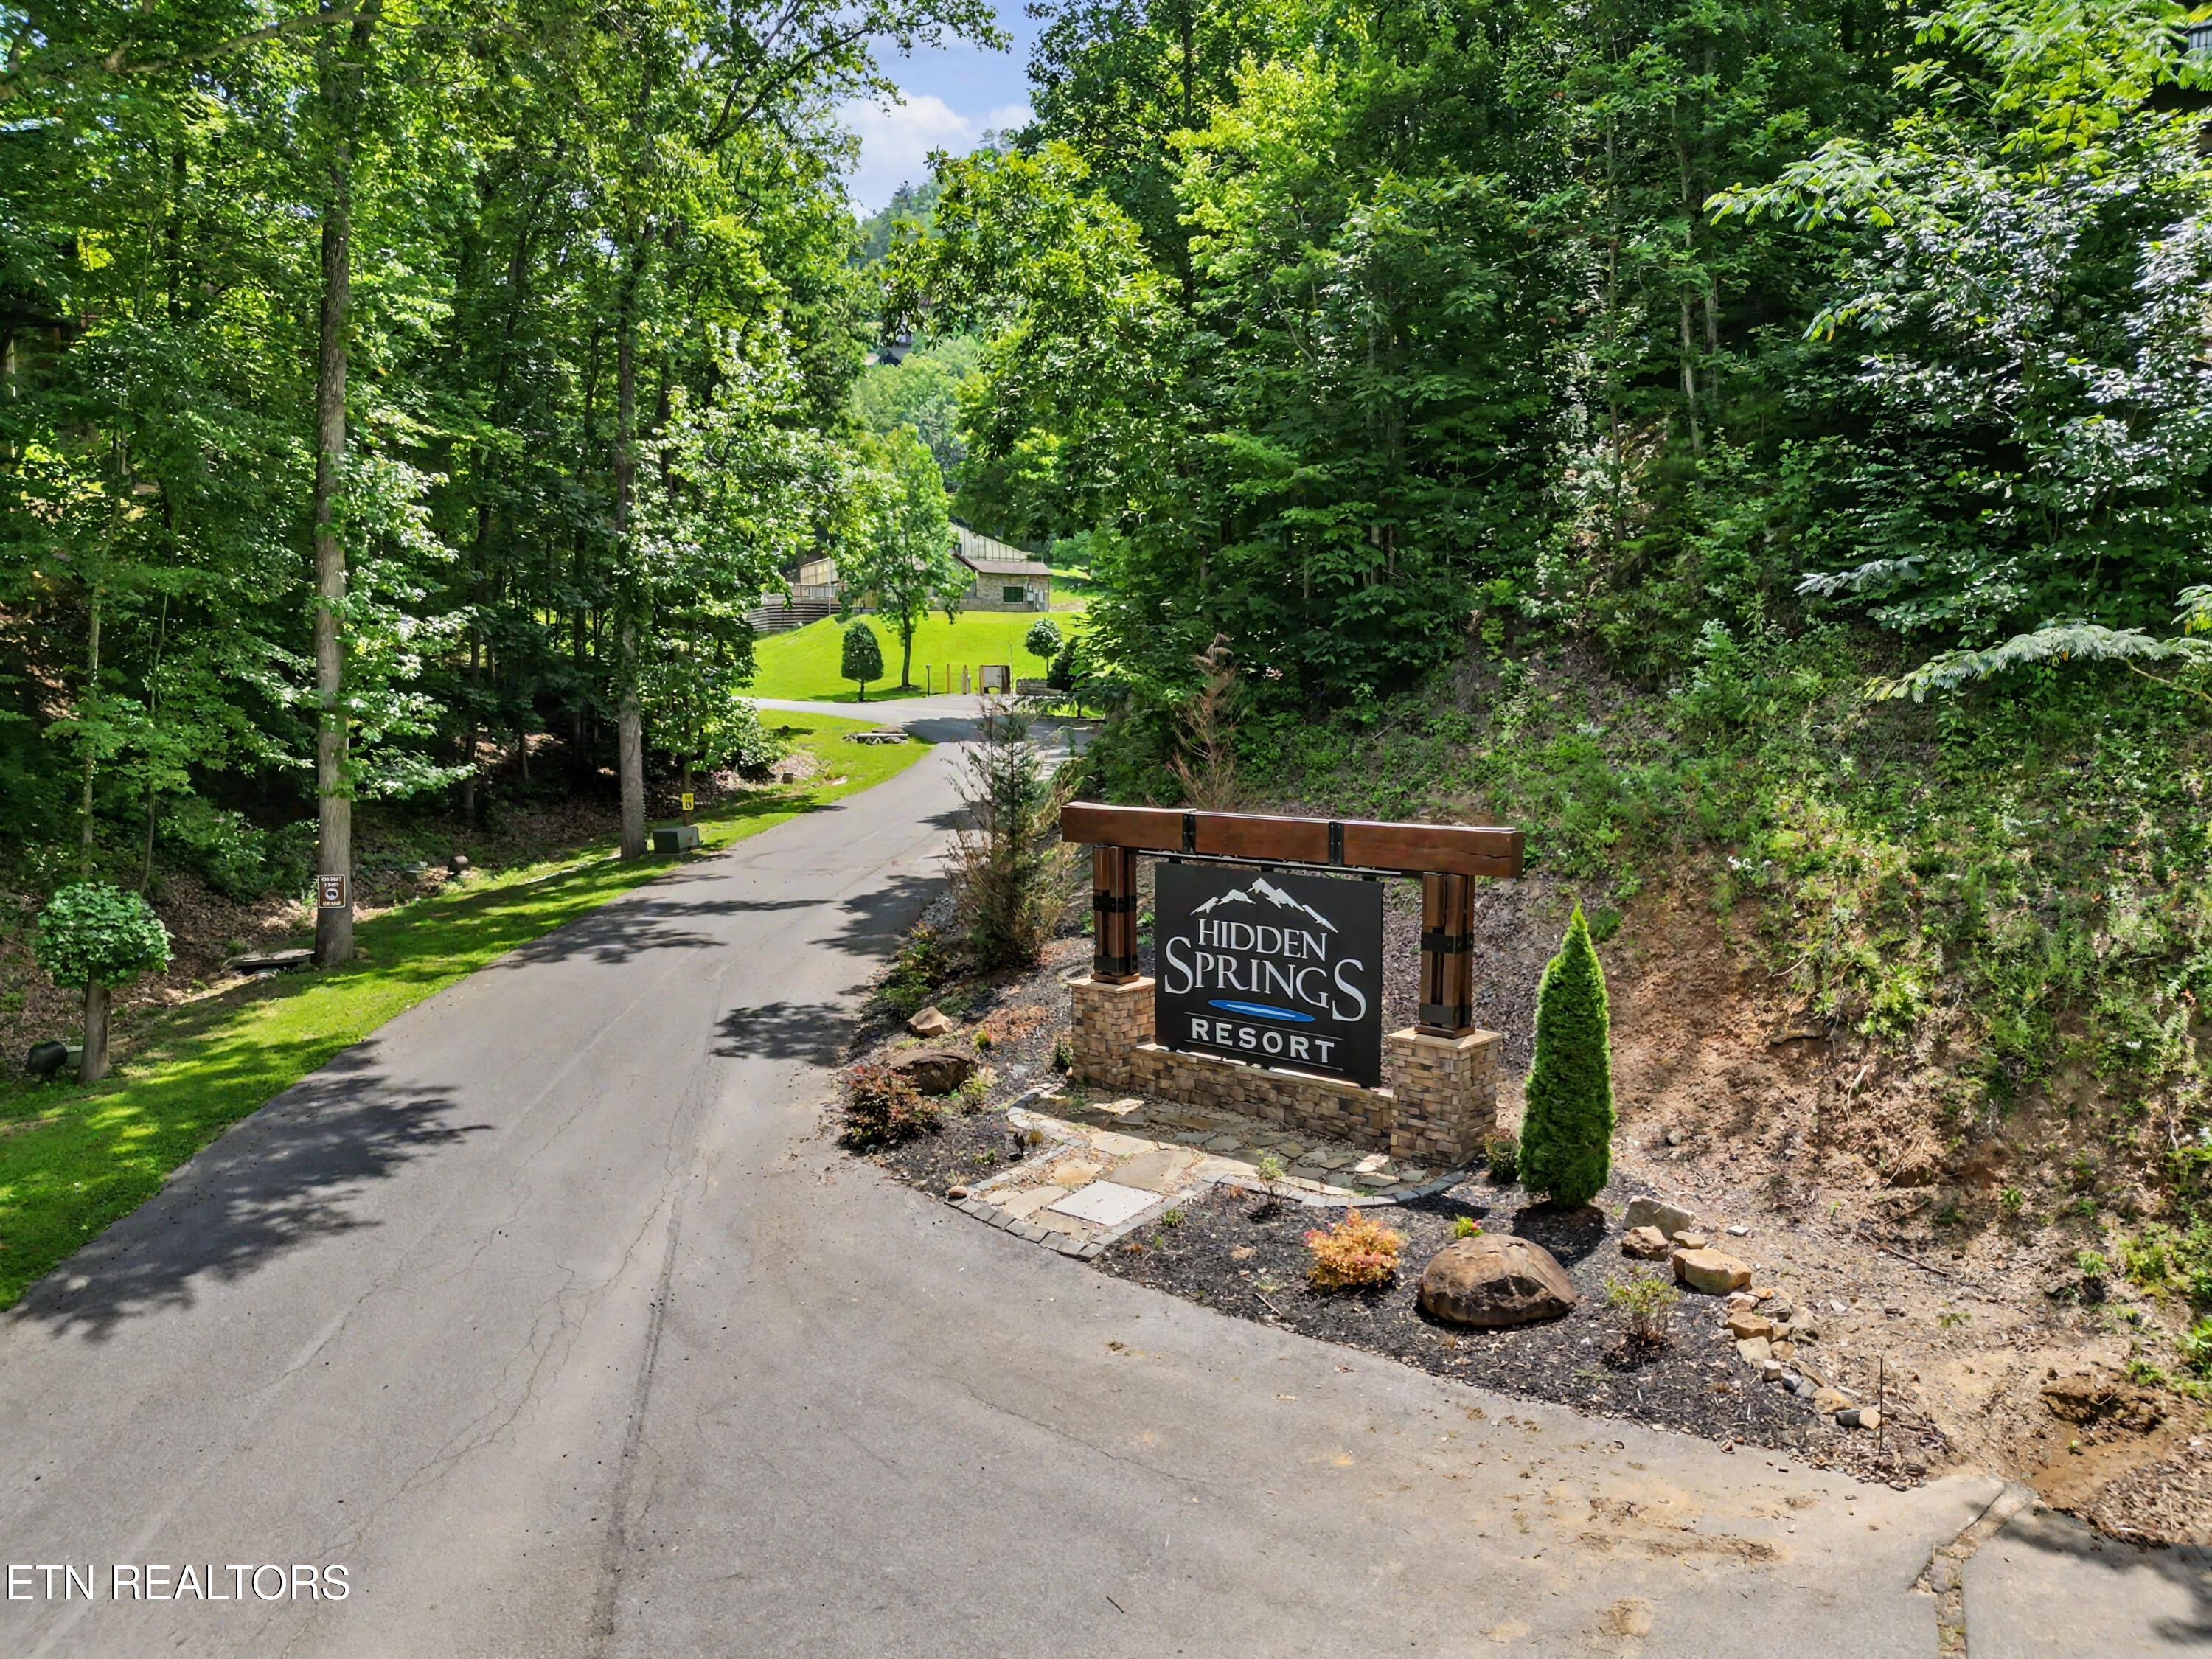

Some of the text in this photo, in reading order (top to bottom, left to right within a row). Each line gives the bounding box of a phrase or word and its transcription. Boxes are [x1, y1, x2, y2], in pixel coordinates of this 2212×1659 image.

[1198, 918, 1328, 963] HIDDEN
[1164, 936, 1367, 1022] SPRINGS
[1192, 1018, 1335, 1063] RESORT
